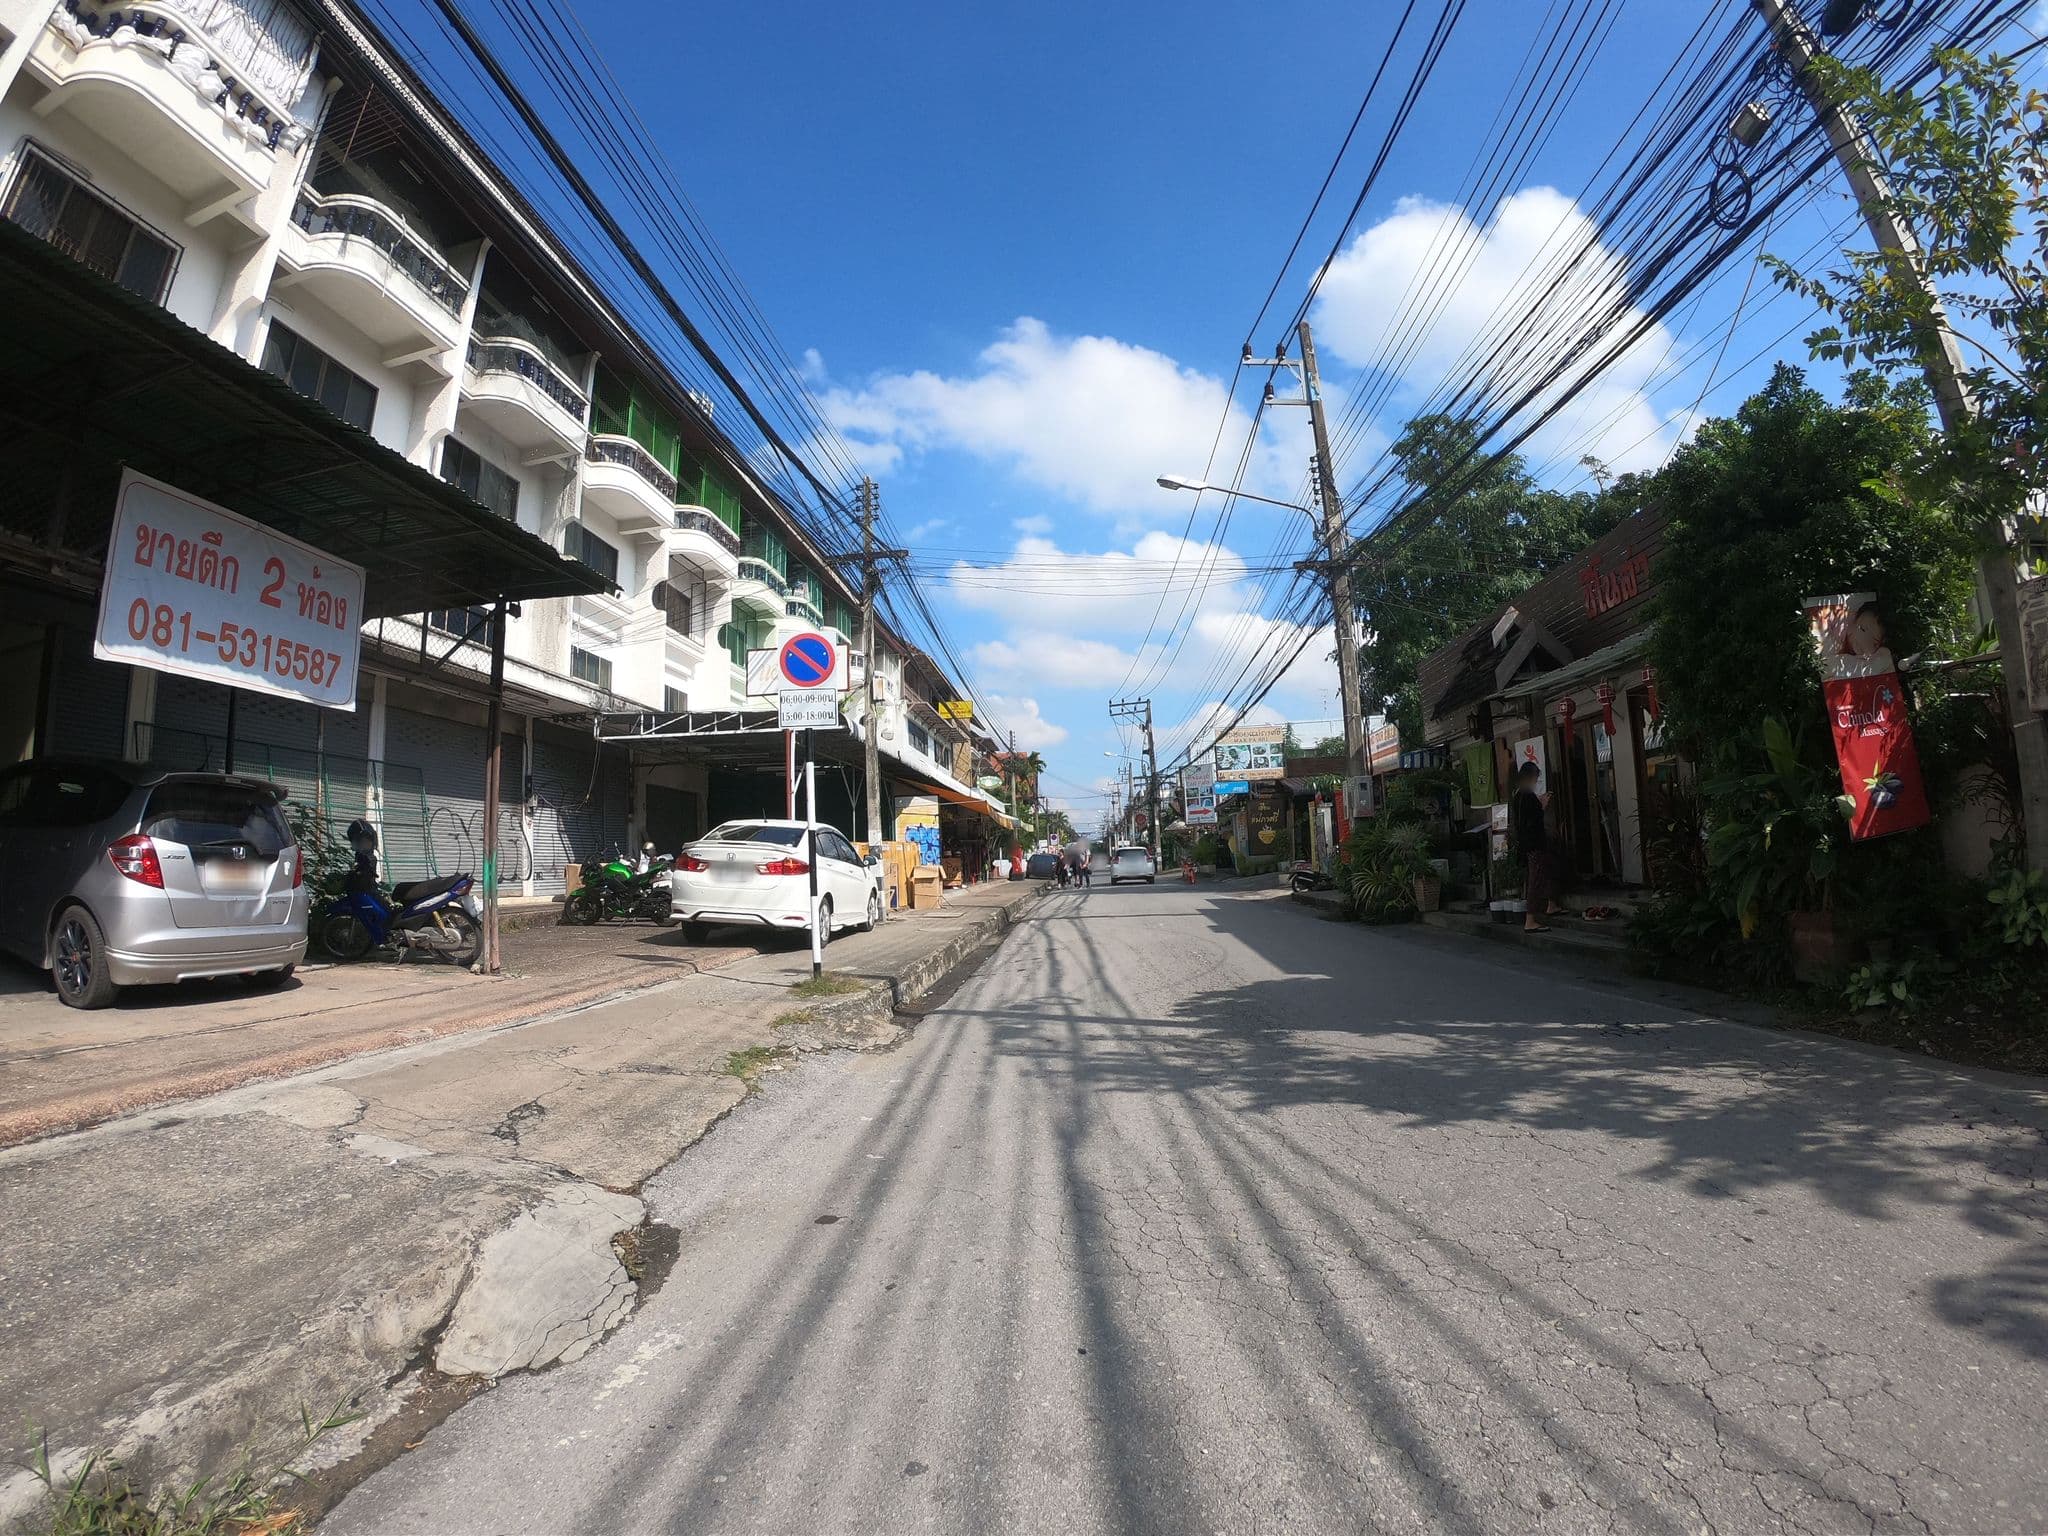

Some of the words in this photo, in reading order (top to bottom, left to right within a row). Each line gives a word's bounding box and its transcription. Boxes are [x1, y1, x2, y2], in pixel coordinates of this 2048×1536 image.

[135, 524, 239, 593] ขายตึก
[260, 557, 287, 608] 2
[298, 566, 347, 630] ห้อง
[128, 598, 341, 688] 081-5315587
